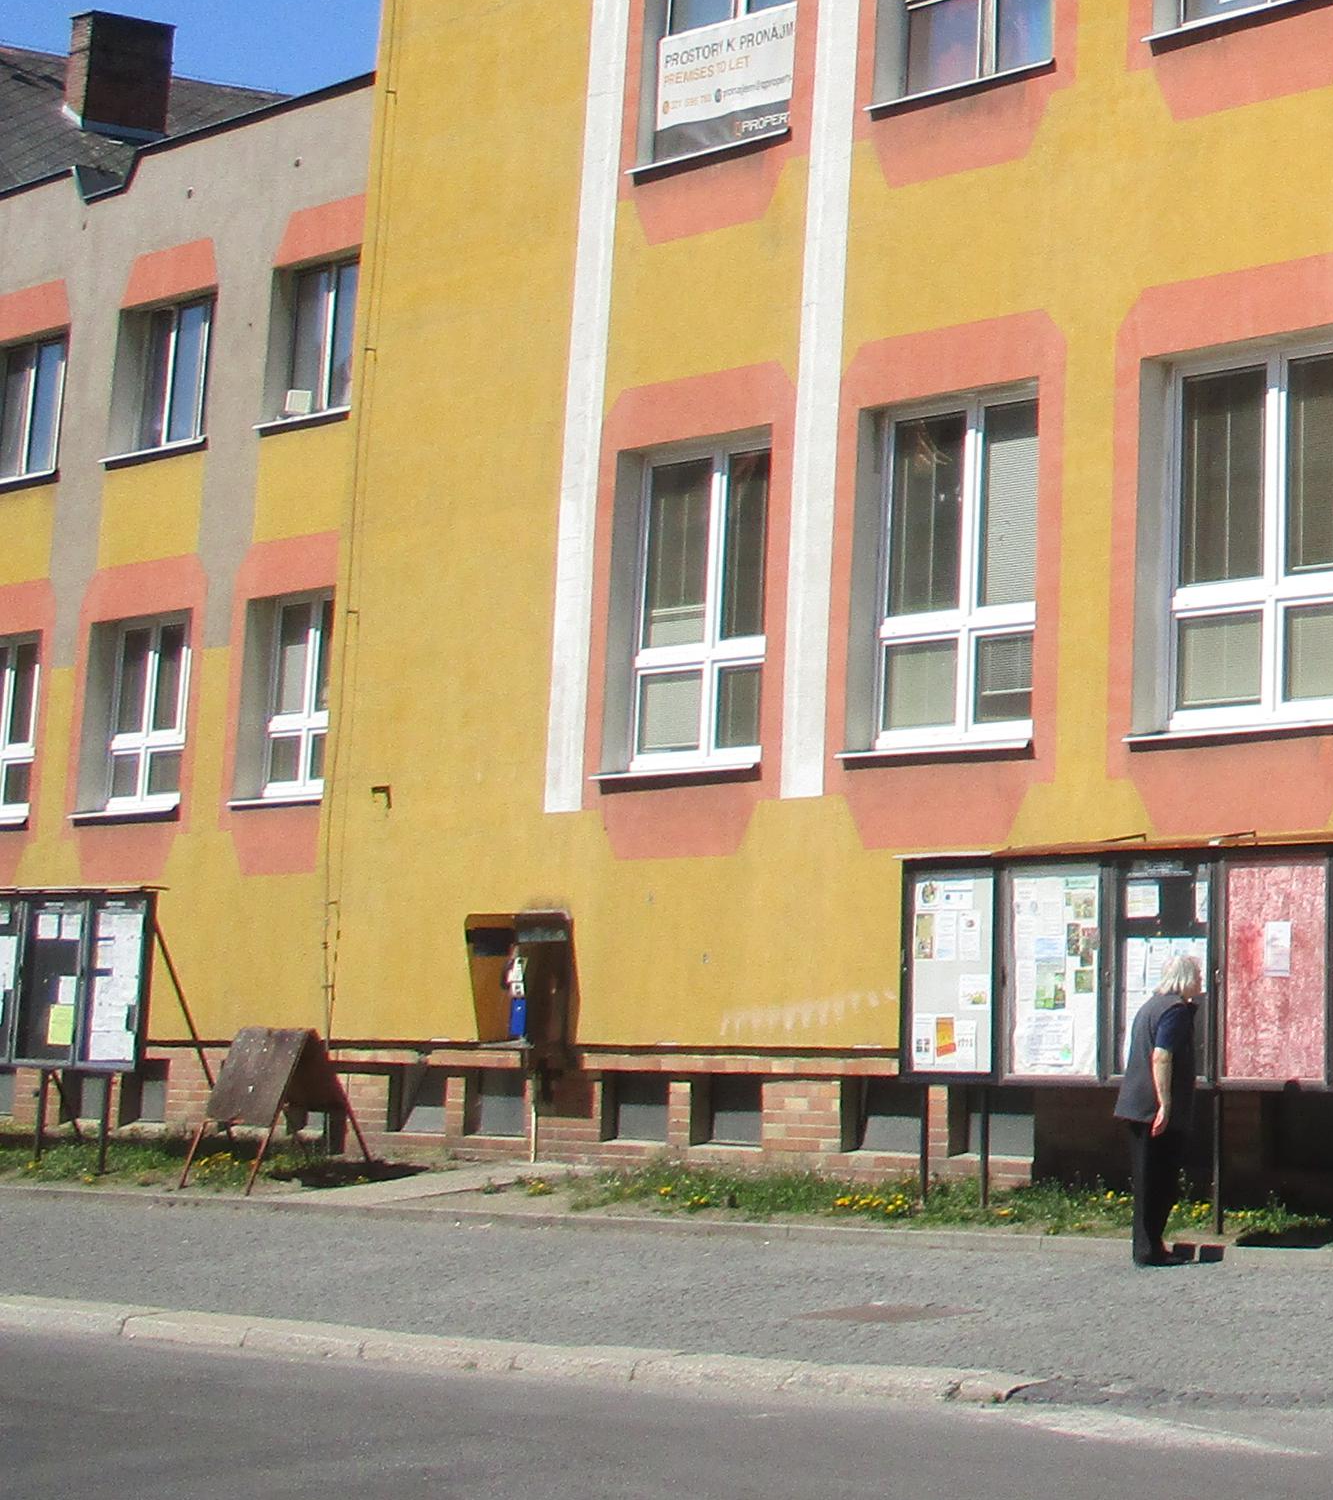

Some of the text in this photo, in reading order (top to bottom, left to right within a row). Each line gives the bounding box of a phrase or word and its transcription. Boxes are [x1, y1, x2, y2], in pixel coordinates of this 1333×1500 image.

[664, 42, 723, 69] PROSTORY
[726, 38, 736, 53] K
[664, 64, 714, 85] PREMISES
[729, 55, 752, 70] LET
